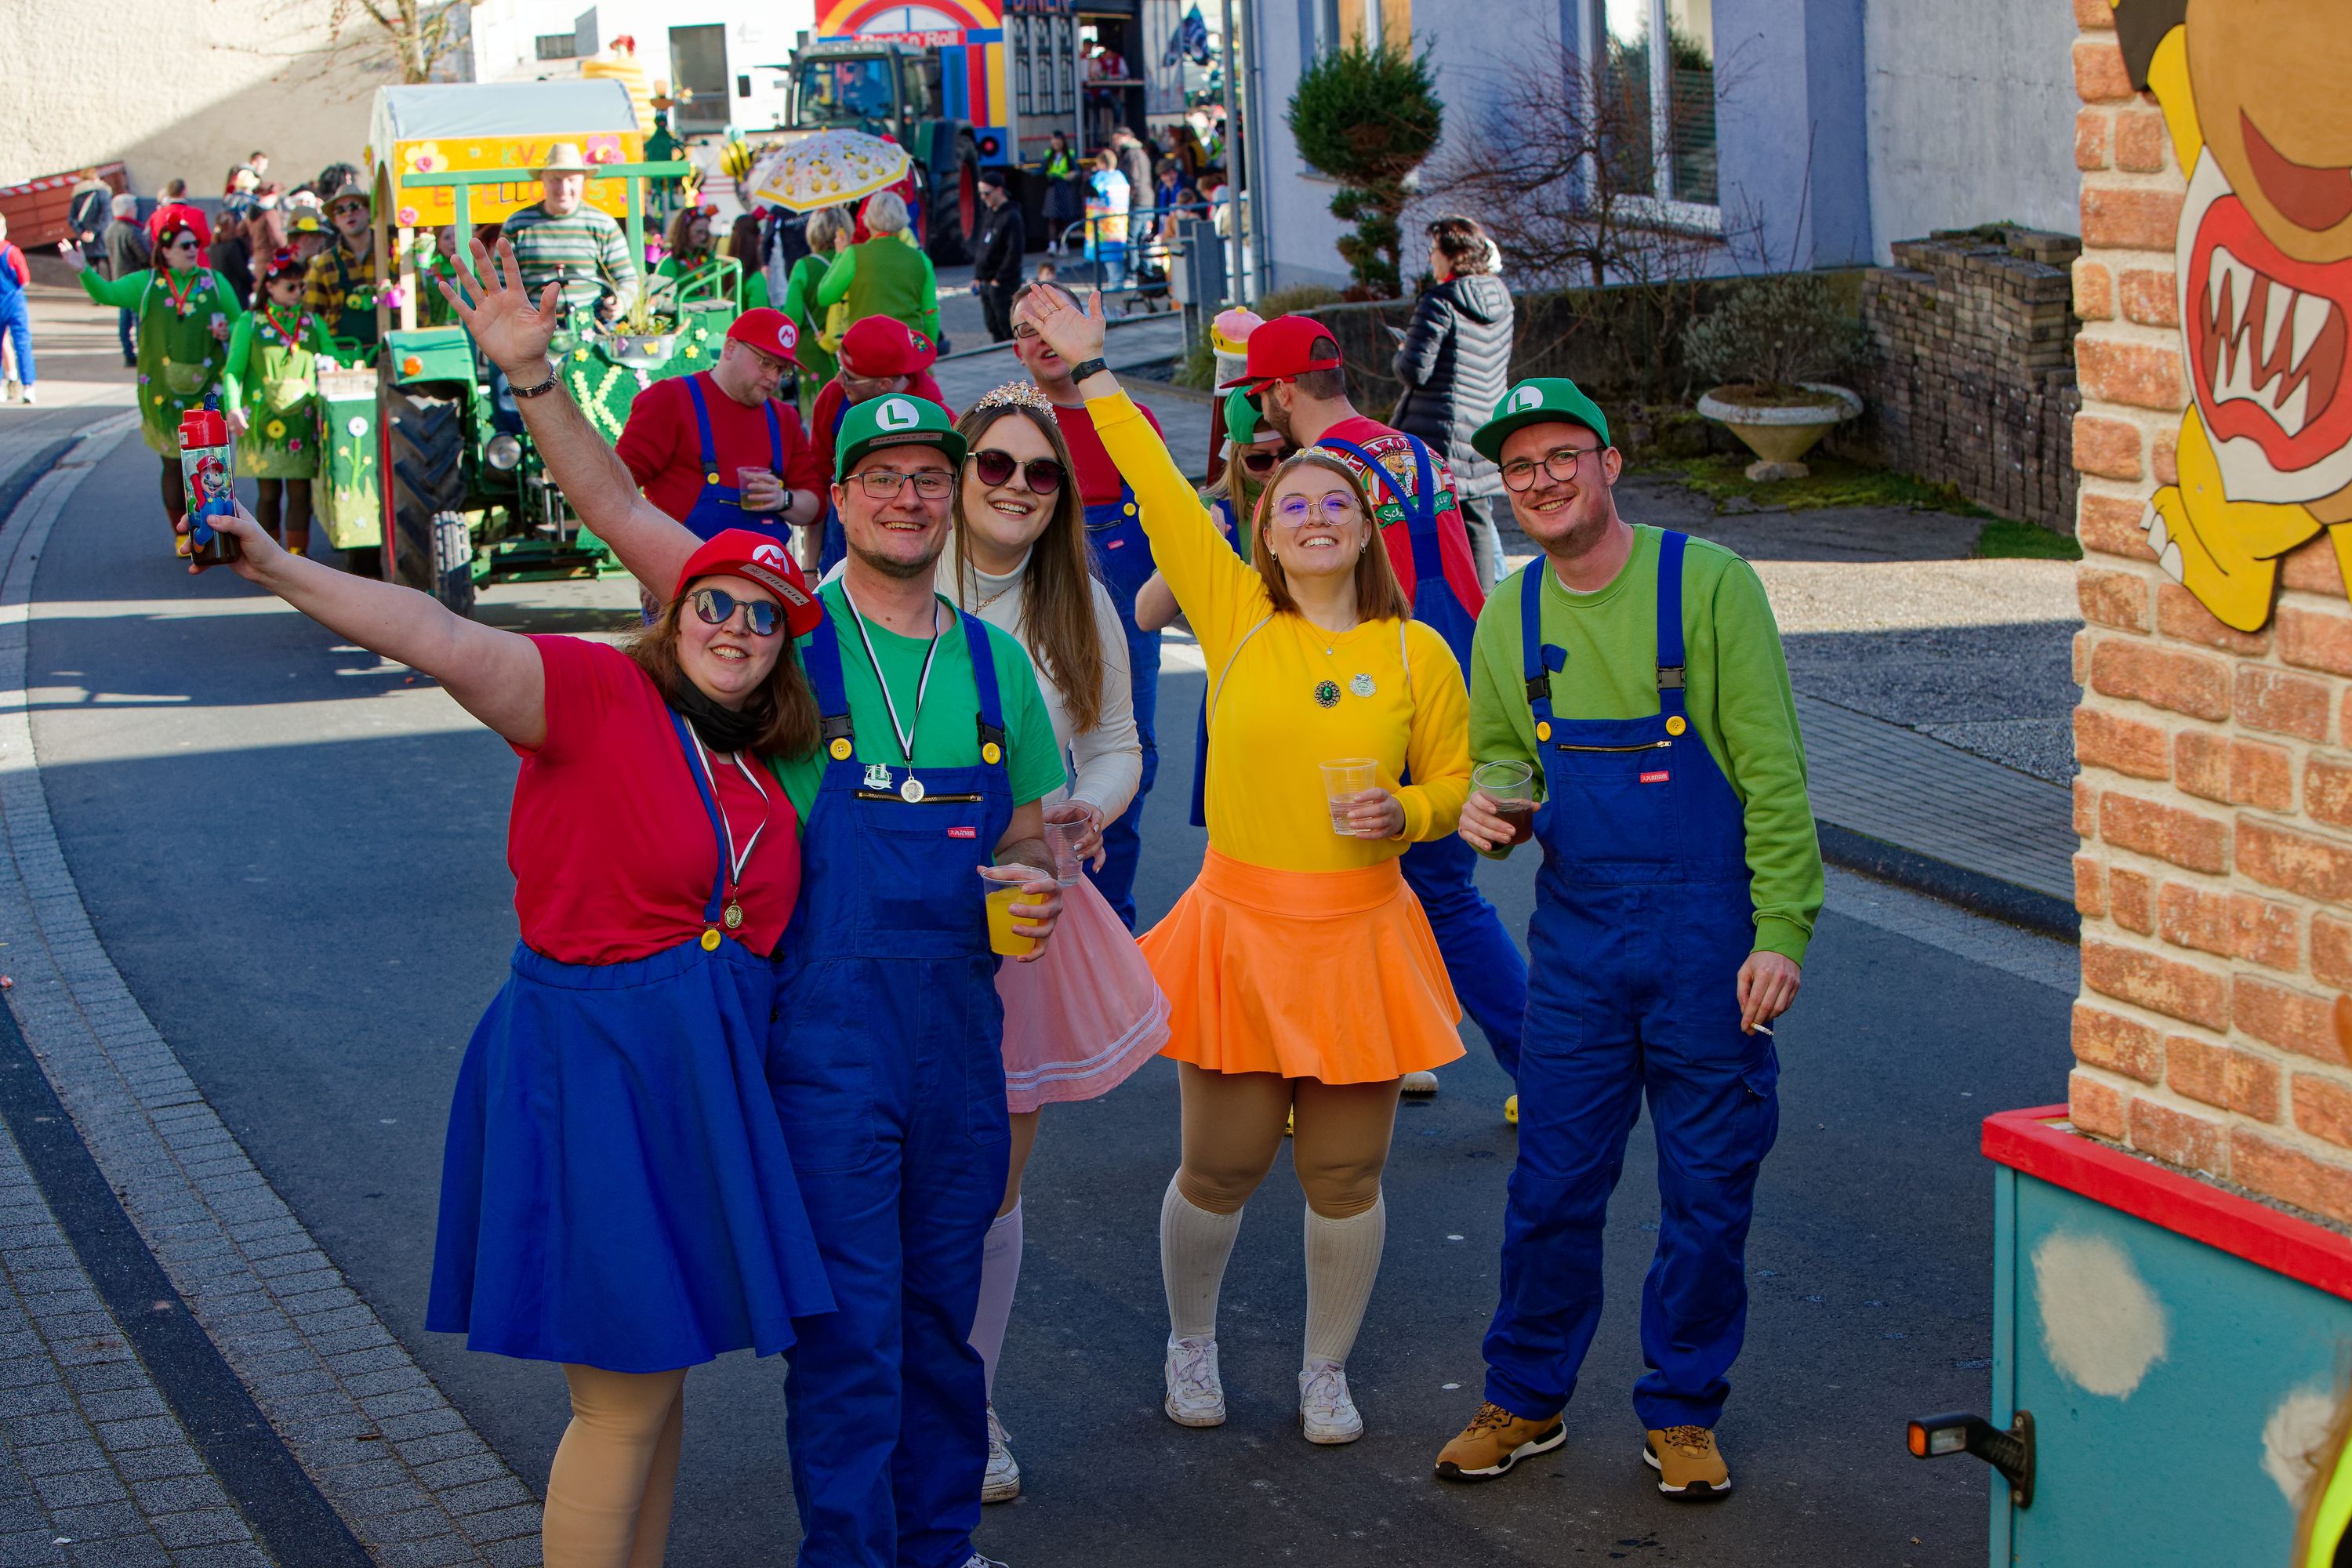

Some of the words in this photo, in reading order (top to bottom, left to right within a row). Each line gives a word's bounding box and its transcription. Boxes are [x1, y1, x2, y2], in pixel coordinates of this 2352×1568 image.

[925, 31, 958, 46] Roll
[781, 328, 793, 345] M
[1515, 393, 1533, 412] L
[887, 404, 909, 425] L
[757, 549, 784, 571] M
